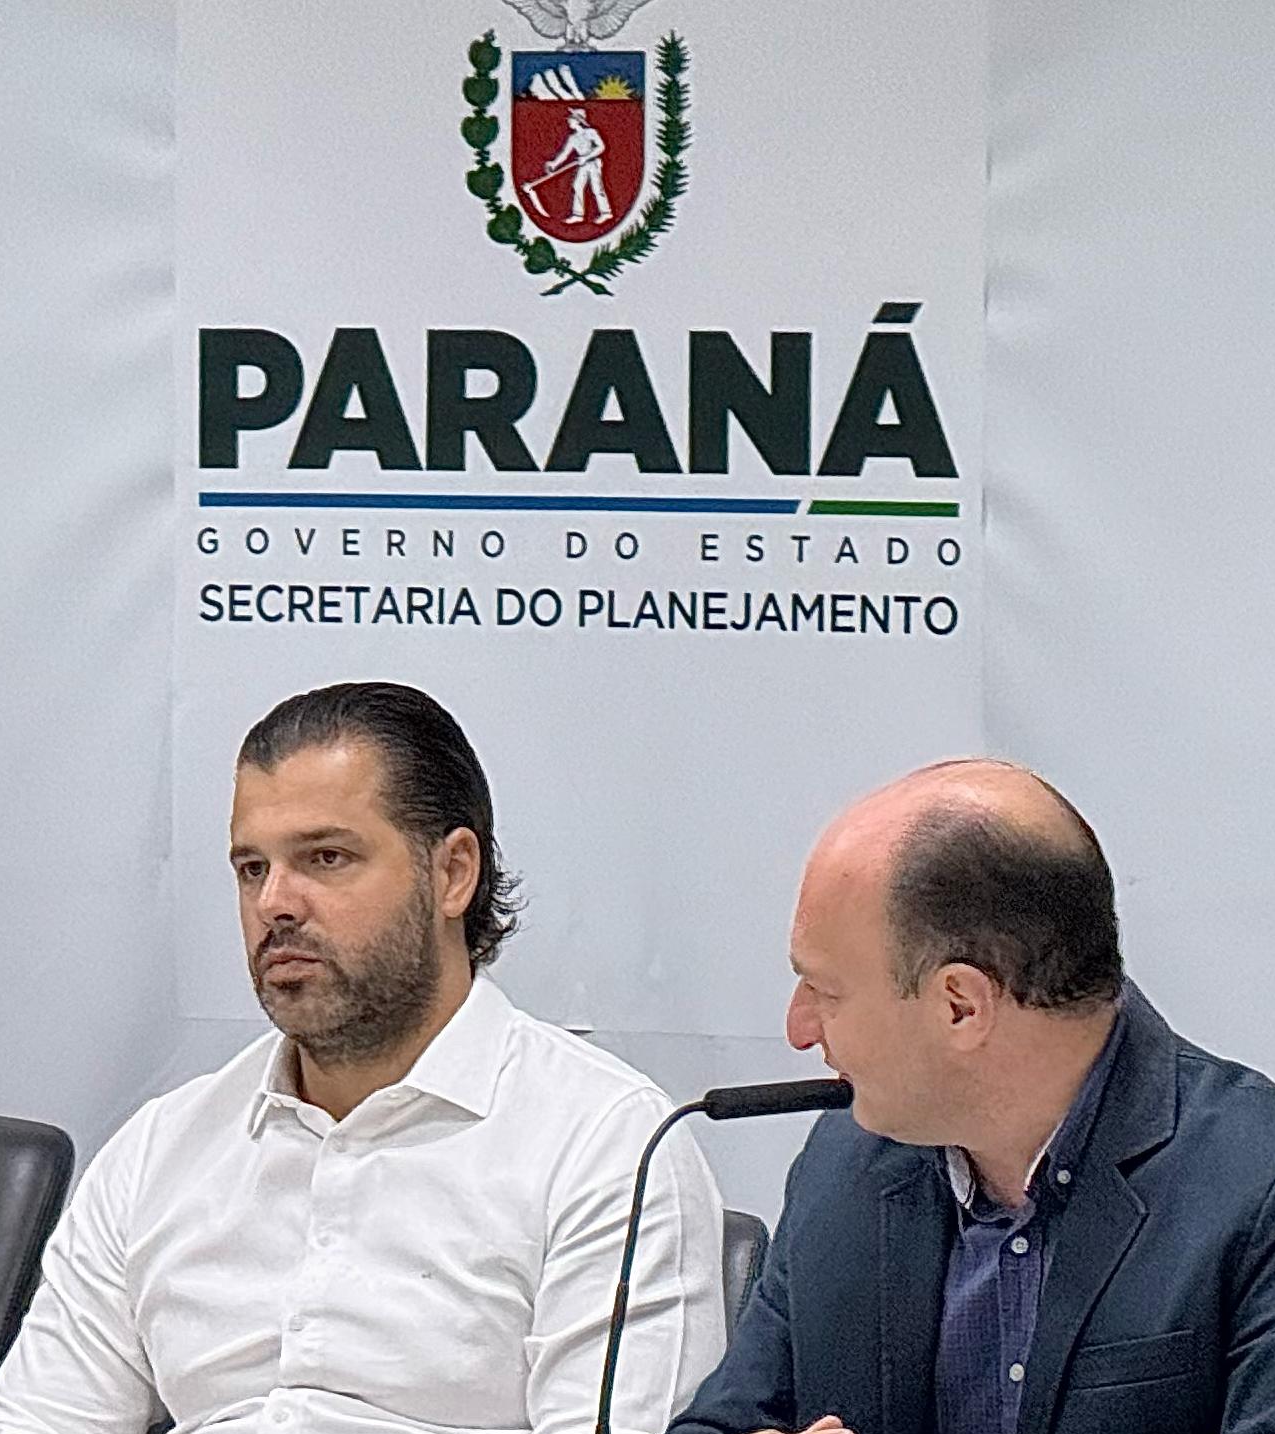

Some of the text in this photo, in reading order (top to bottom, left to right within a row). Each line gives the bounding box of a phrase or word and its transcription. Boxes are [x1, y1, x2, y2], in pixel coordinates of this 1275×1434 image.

[198, 301, 960, 479] PARANÁ
[197, 526, 961, 566] GOVERNO DO ESTADO
[199, 583, 958, 636] SECRETARIA DO PLANEJAMENTO
